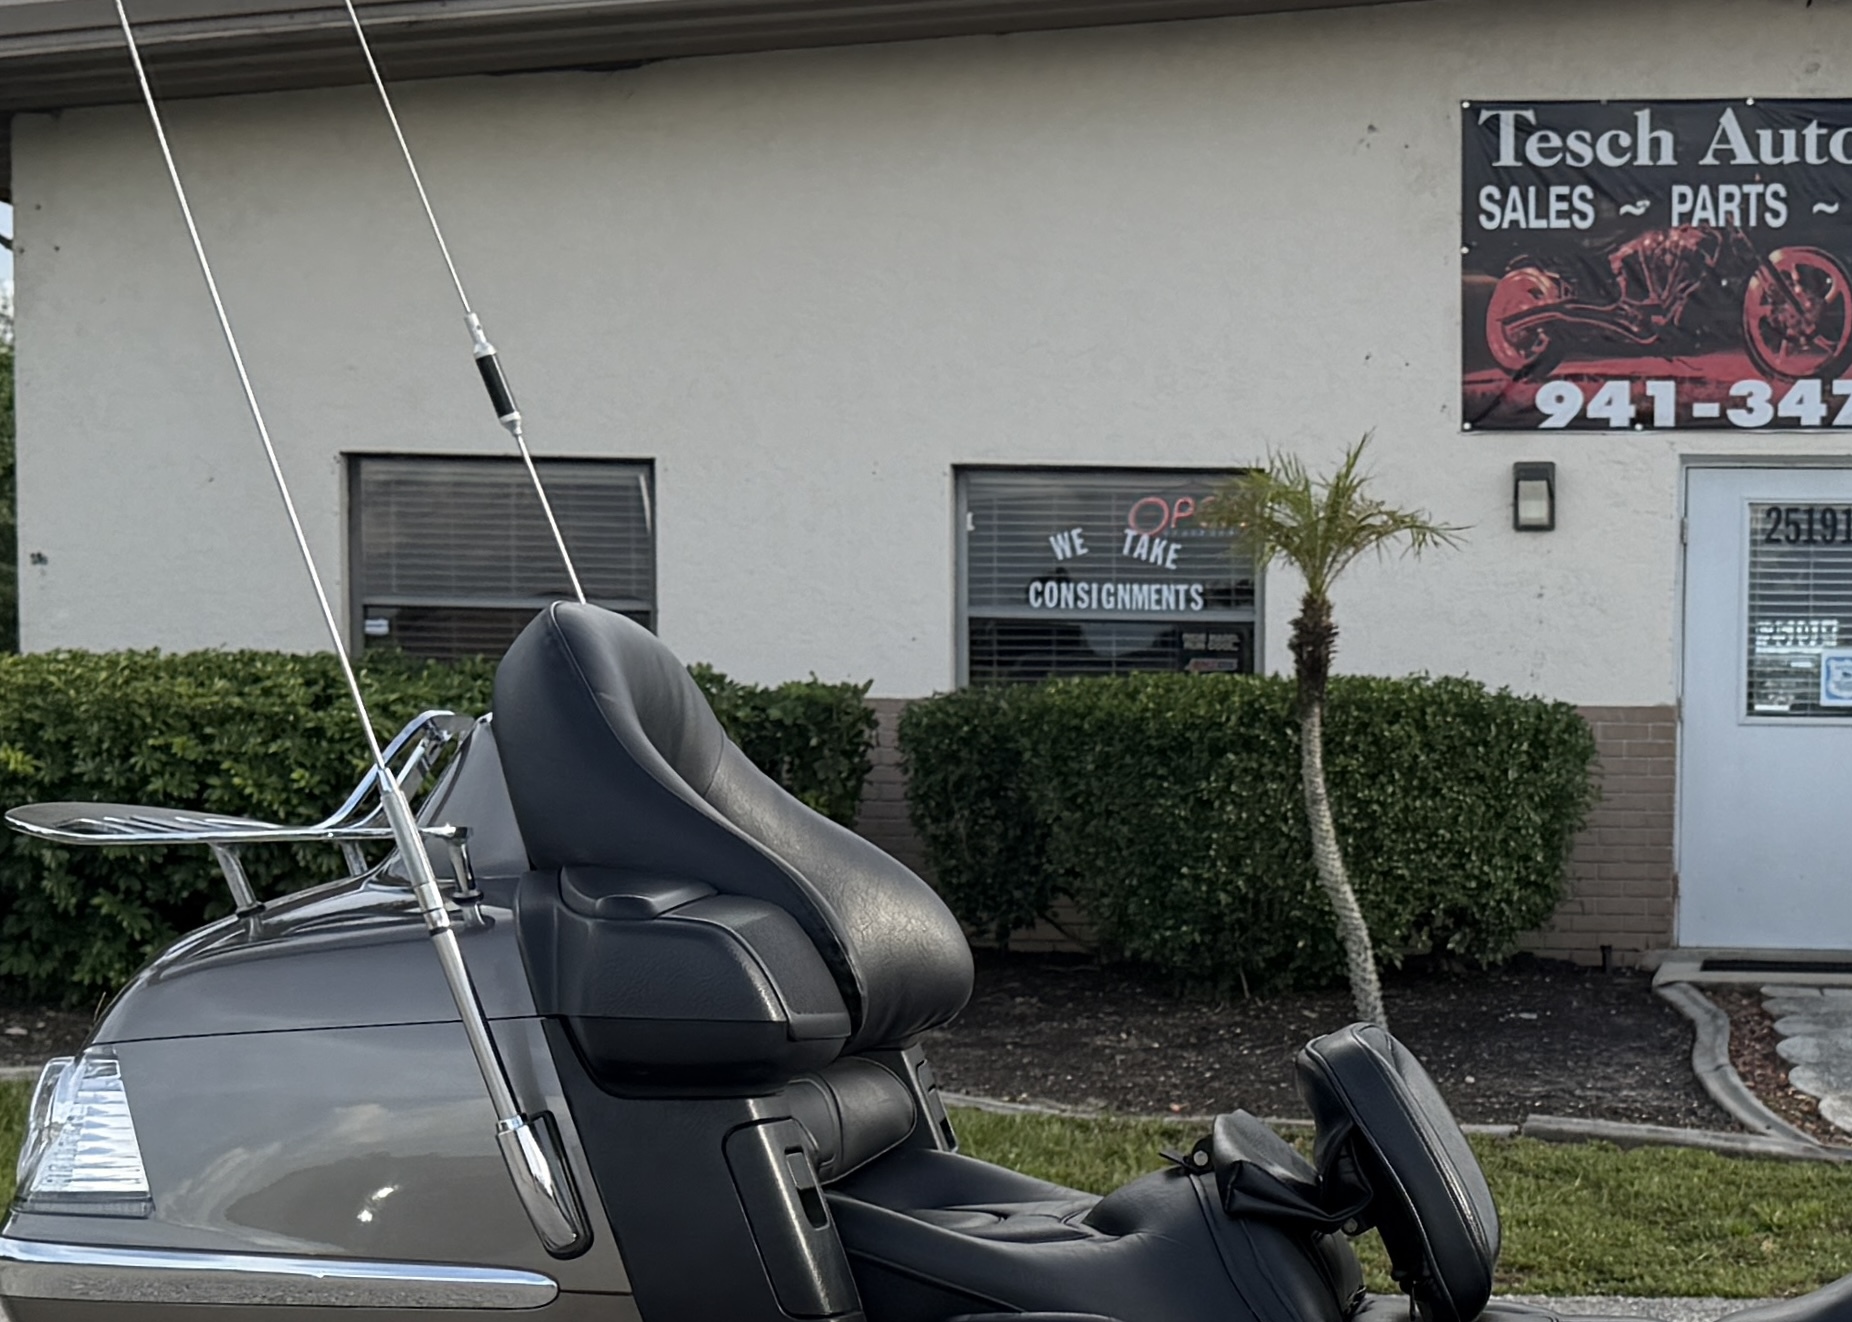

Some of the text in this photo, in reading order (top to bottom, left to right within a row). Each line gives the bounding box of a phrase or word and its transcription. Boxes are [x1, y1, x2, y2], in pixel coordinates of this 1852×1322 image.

[1479, 109, 1677, 167] Tesch
[1479, 185, 1594, 229] SALES
[1672, 183, 1787, 227] PARTS
[1049, 527, 1182, 570] WE TAKE
[1028, 580, 1204, 611] CONSIGNMENTS
